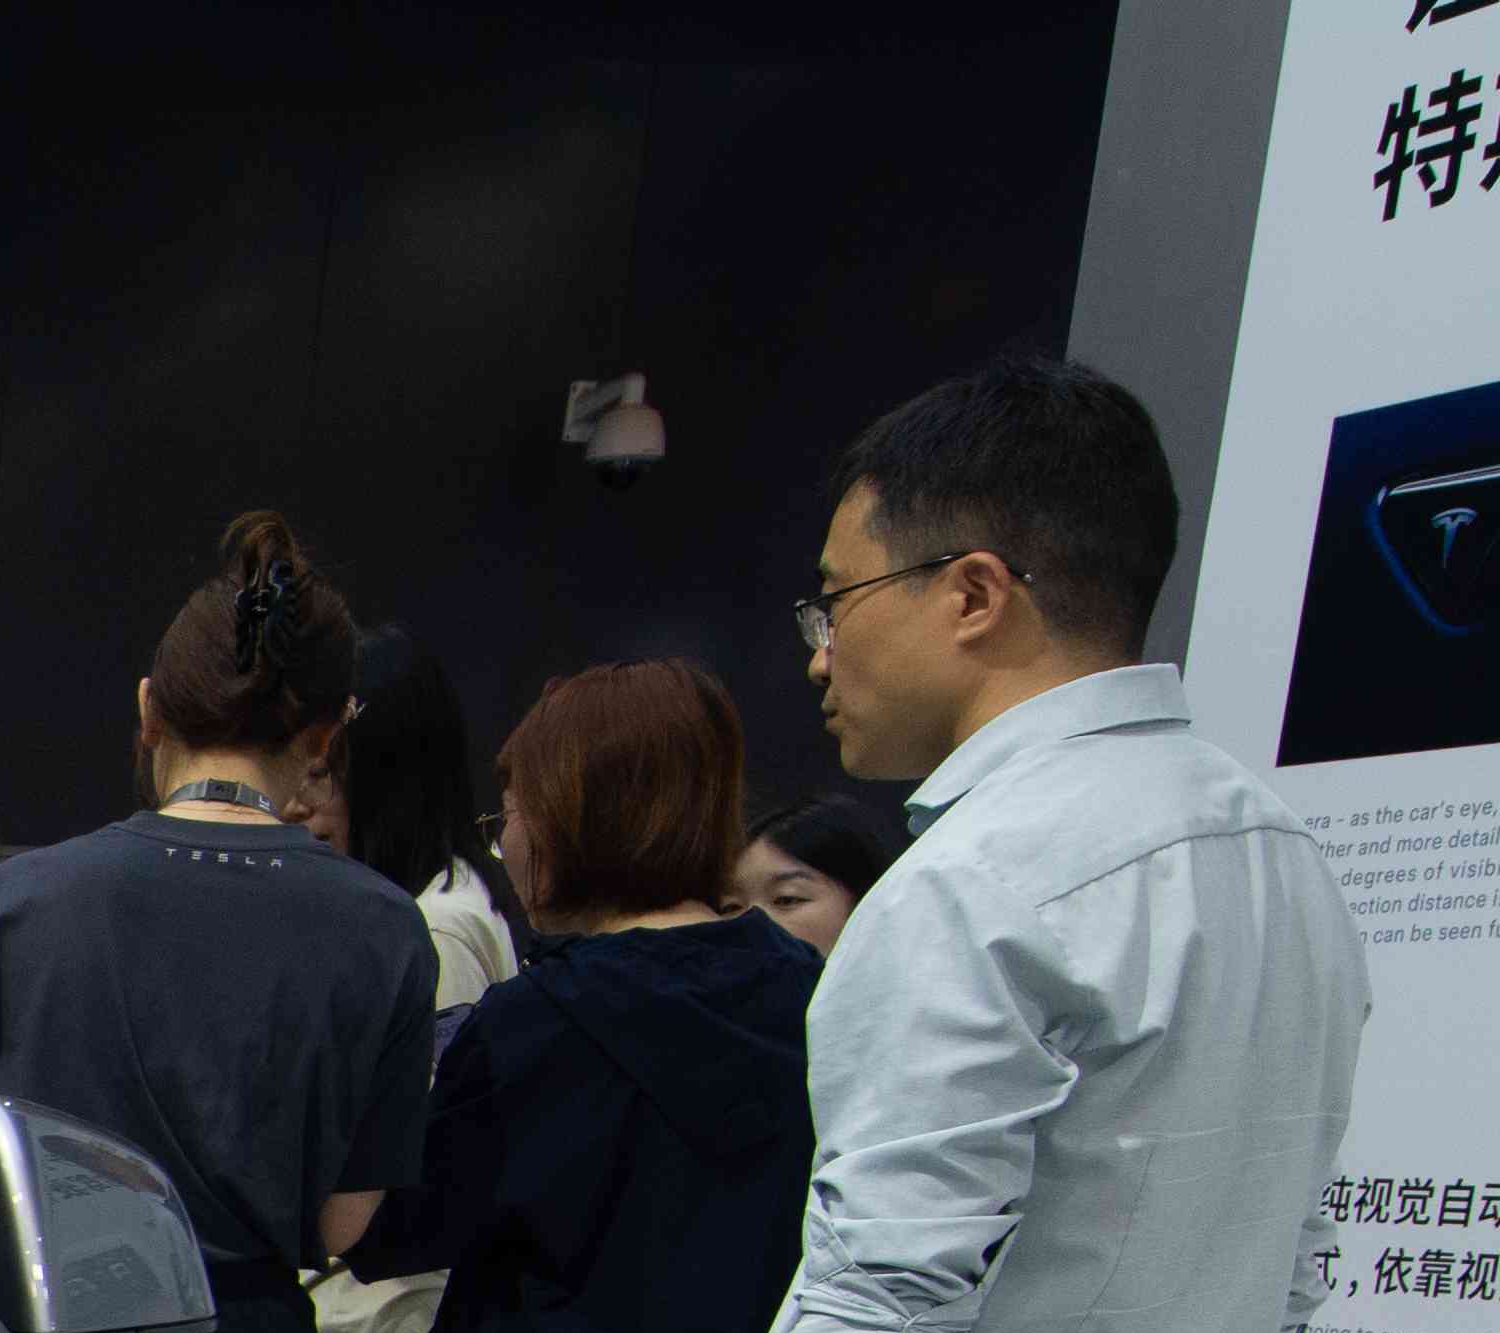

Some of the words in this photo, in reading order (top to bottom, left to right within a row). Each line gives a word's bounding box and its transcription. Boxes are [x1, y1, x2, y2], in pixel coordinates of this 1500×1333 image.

[1372, 68, 1500, 222] 特
[1350, 812, 1370, 827] as
[1375, 805, 1404, 824] the
[1409, 800, 1455, 822] car's
[1459, 800, 1498, 820] eye,
[1358, 835, 1392, 856] and
[1395, 836, 1443, 853] more
[165, 848, 283, 868] TESLA
[1423, 860, 1444, 881] of
[1407, 890, 1487, 913] distance
[1372, 928, 1405, 944] can
[1409, 923, 1433, 942] be
[1438, 924, 1483, 940] seen
